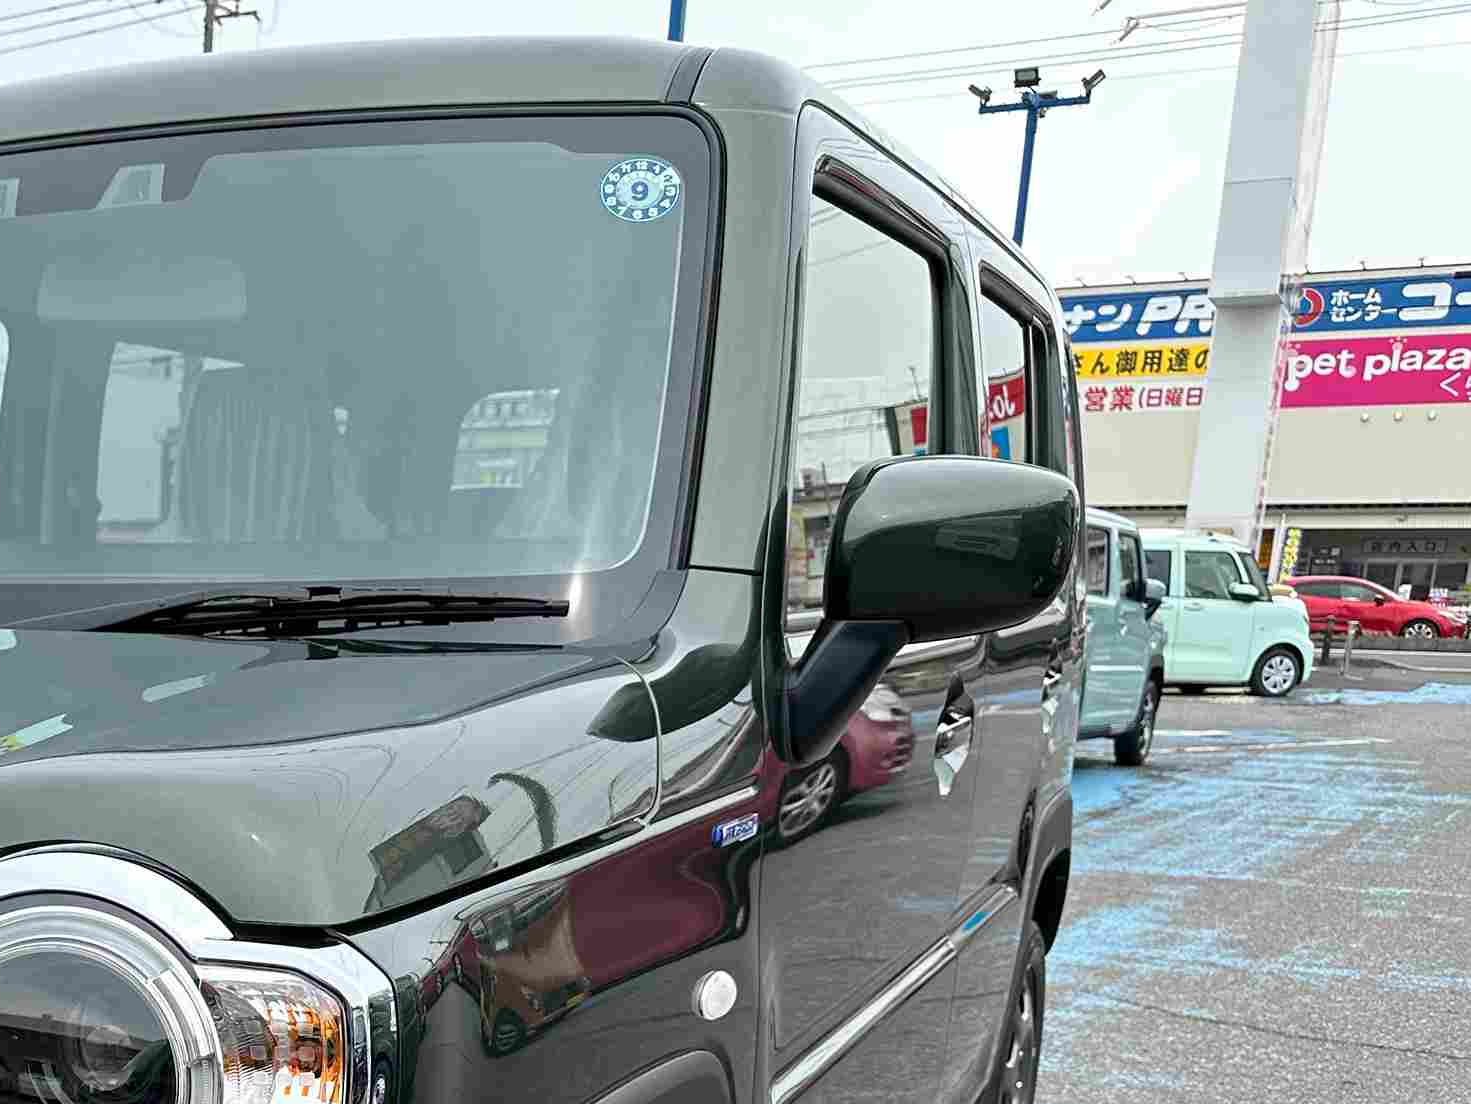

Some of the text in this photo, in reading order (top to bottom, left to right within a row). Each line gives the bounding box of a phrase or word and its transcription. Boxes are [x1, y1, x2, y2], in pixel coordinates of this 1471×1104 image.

[631, 181, 649, 201] 9
[1330, 287, 1382, 306] ホーム
[1329, 303, 1399, 323] センター
[1284, 336, 1471, 392] pet plaza
